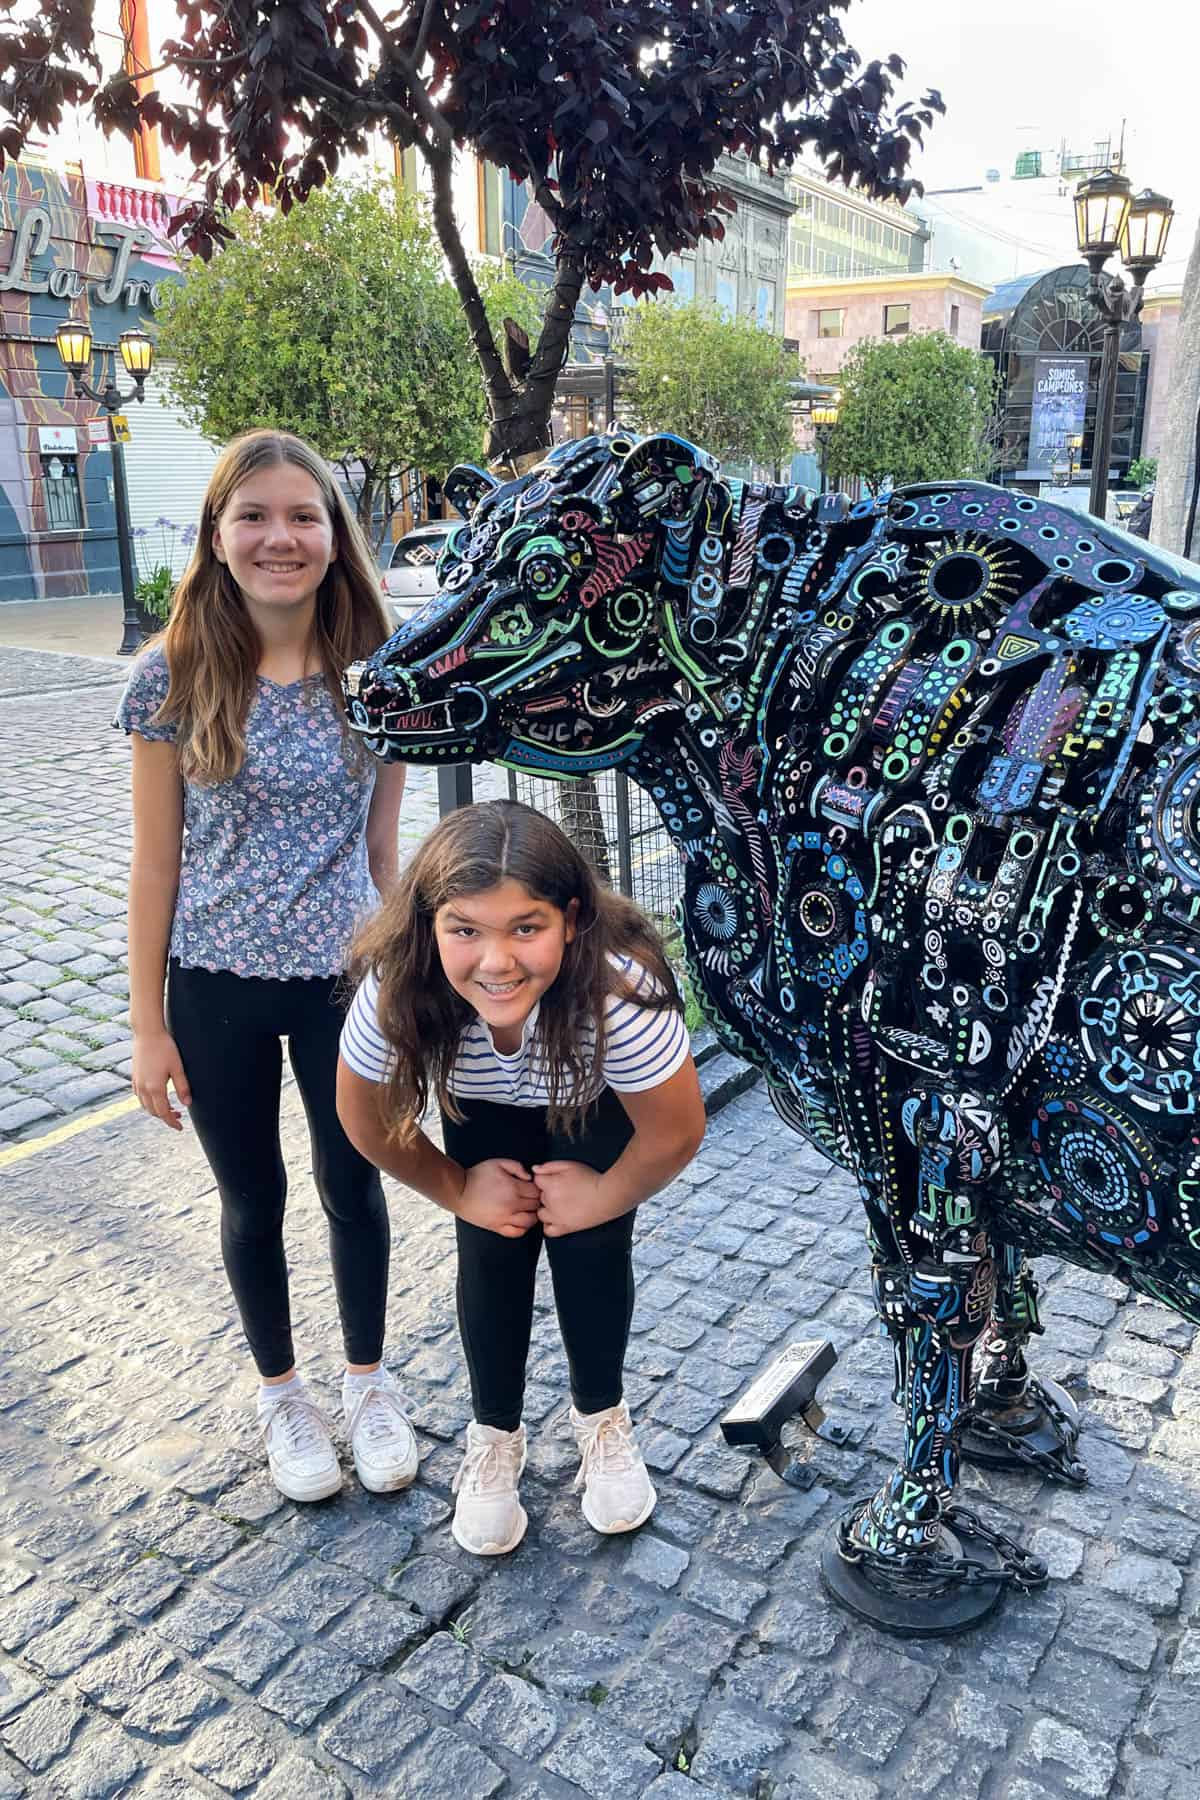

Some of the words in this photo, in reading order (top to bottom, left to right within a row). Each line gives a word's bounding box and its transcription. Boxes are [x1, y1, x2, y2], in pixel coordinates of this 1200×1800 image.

[0, 207, 84, 299] La
[1048, 368, 1076, 381] SOMOS
[1038, 380, 1084, 393] CAMPEONES
